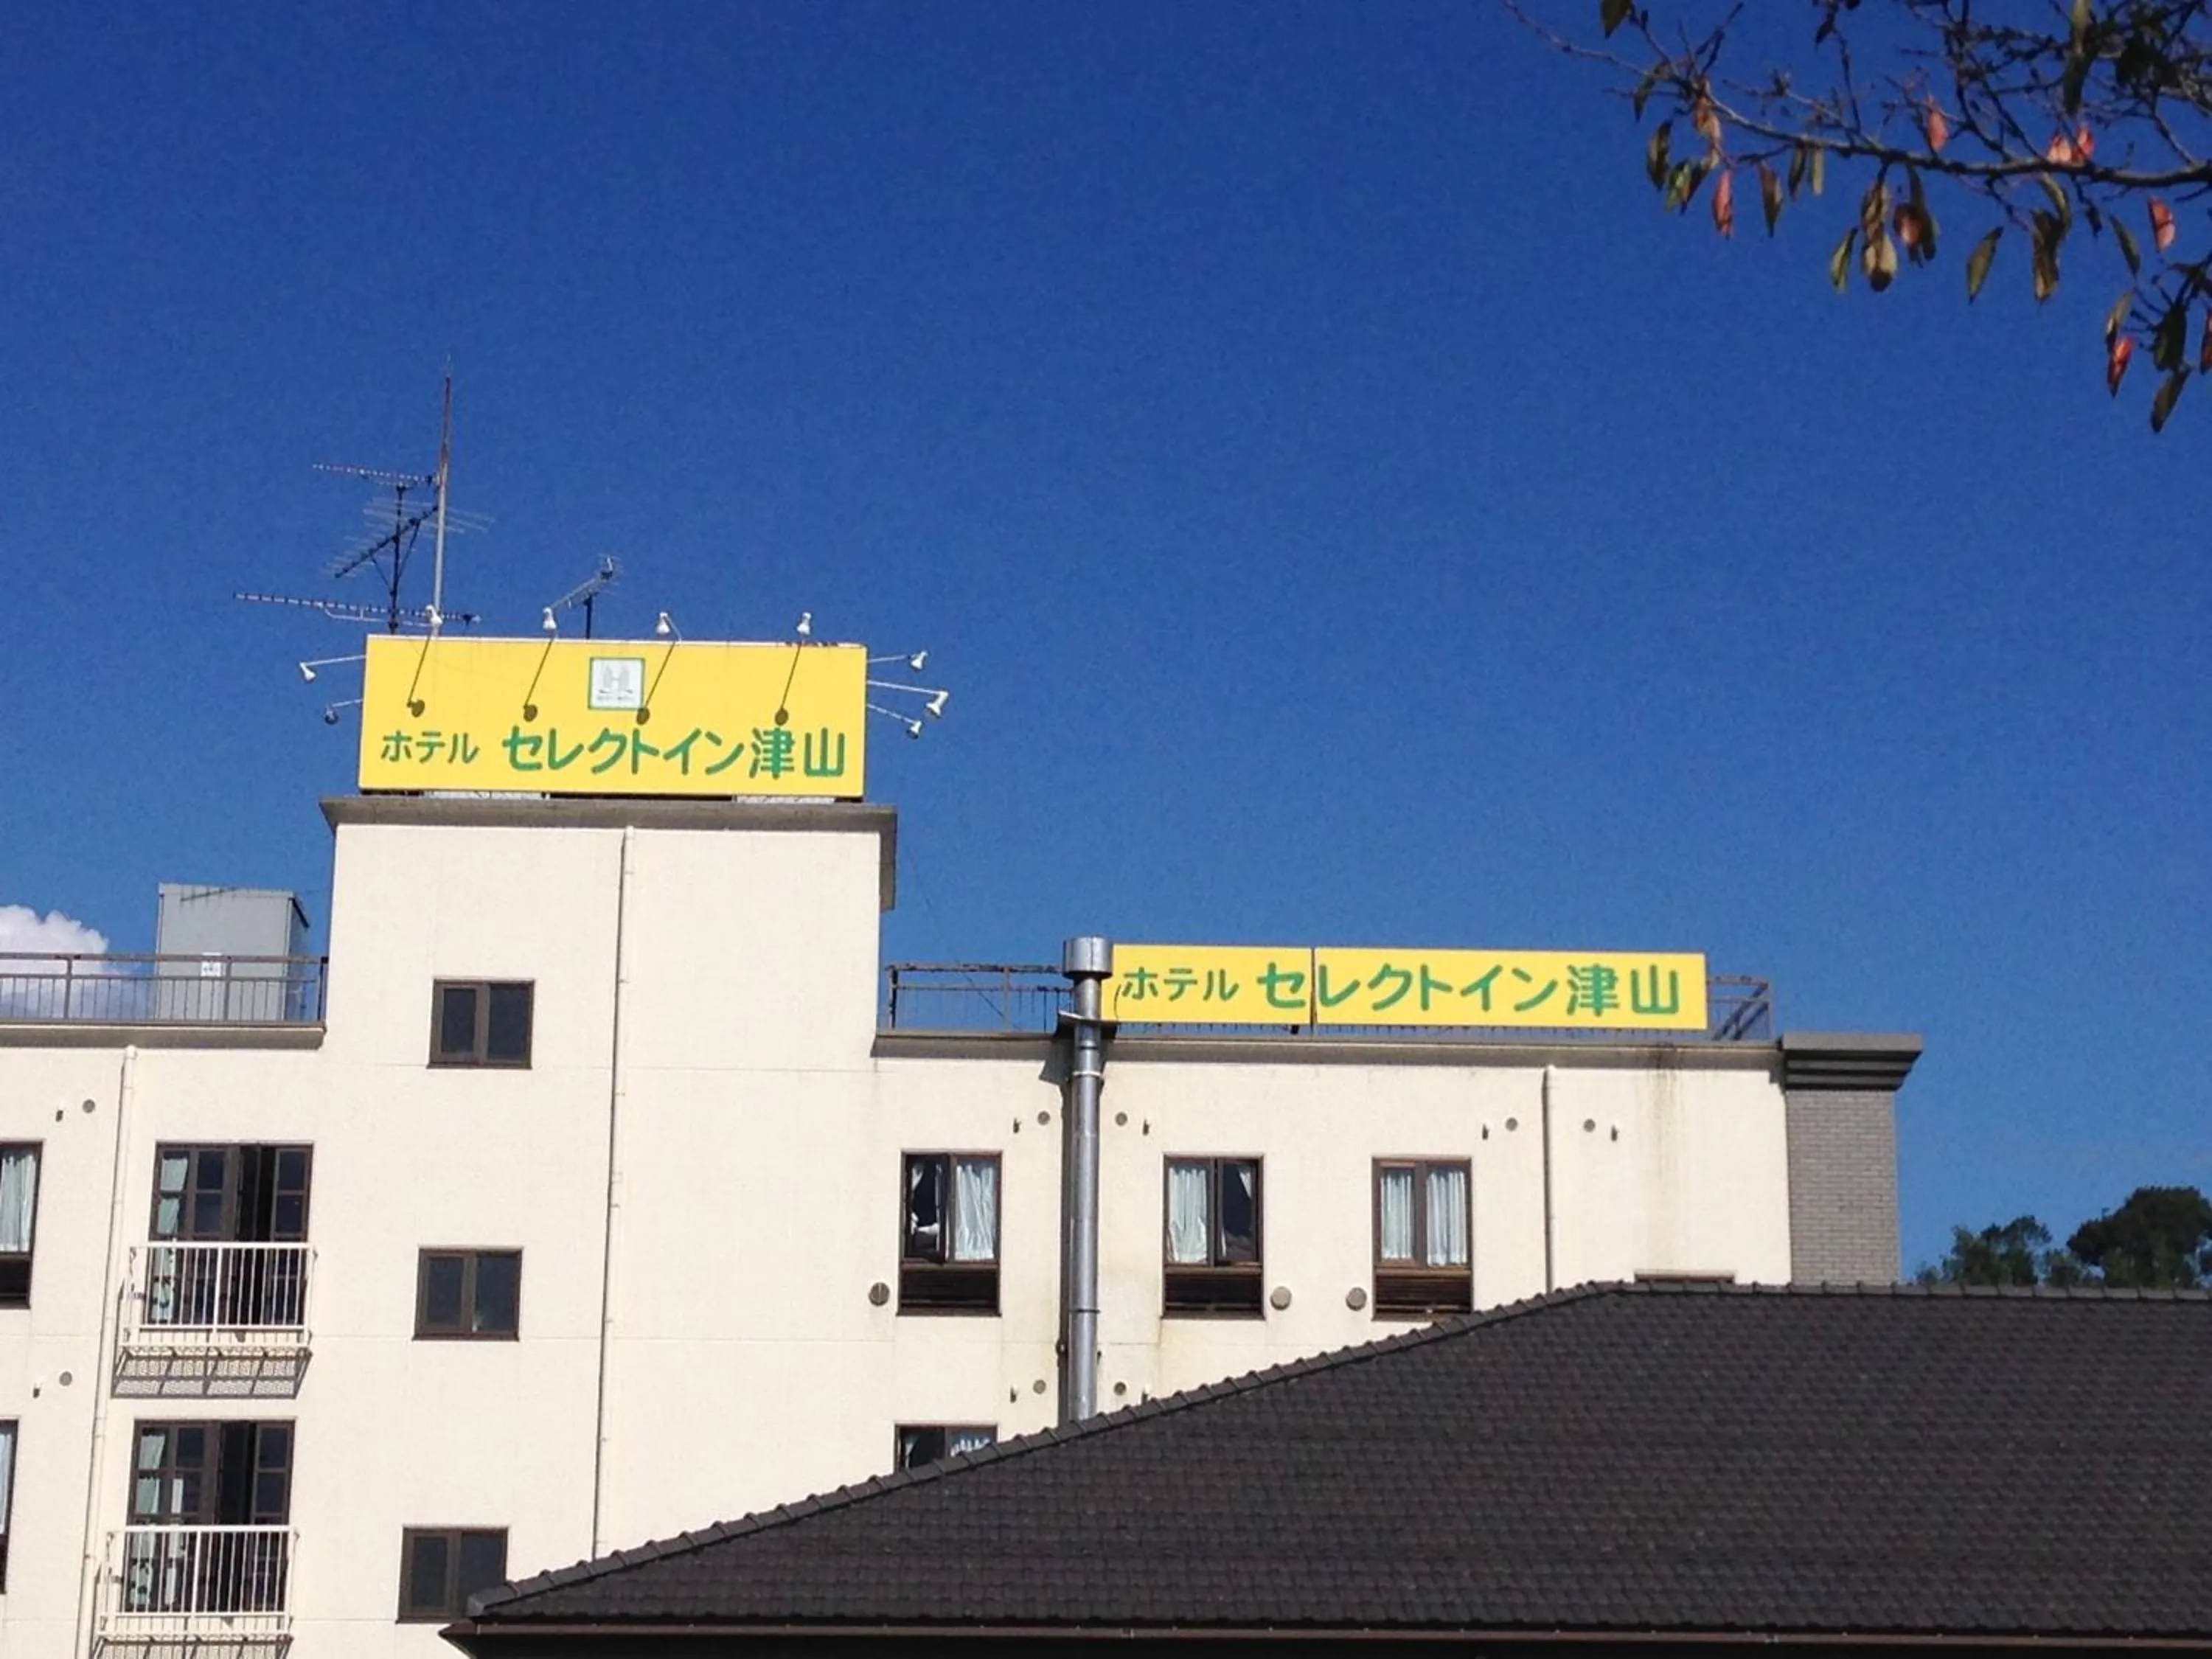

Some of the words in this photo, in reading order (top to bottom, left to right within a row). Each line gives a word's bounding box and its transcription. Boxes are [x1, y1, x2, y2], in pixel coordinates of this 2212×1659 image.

[380, 729, 480, 764] ホテル
[502, 725, 846, 779] セレクトイン津山
[1121, 967, 1239, 1001] ホテル
[1256, 962, 1680, 1017] セレクトイン津山
